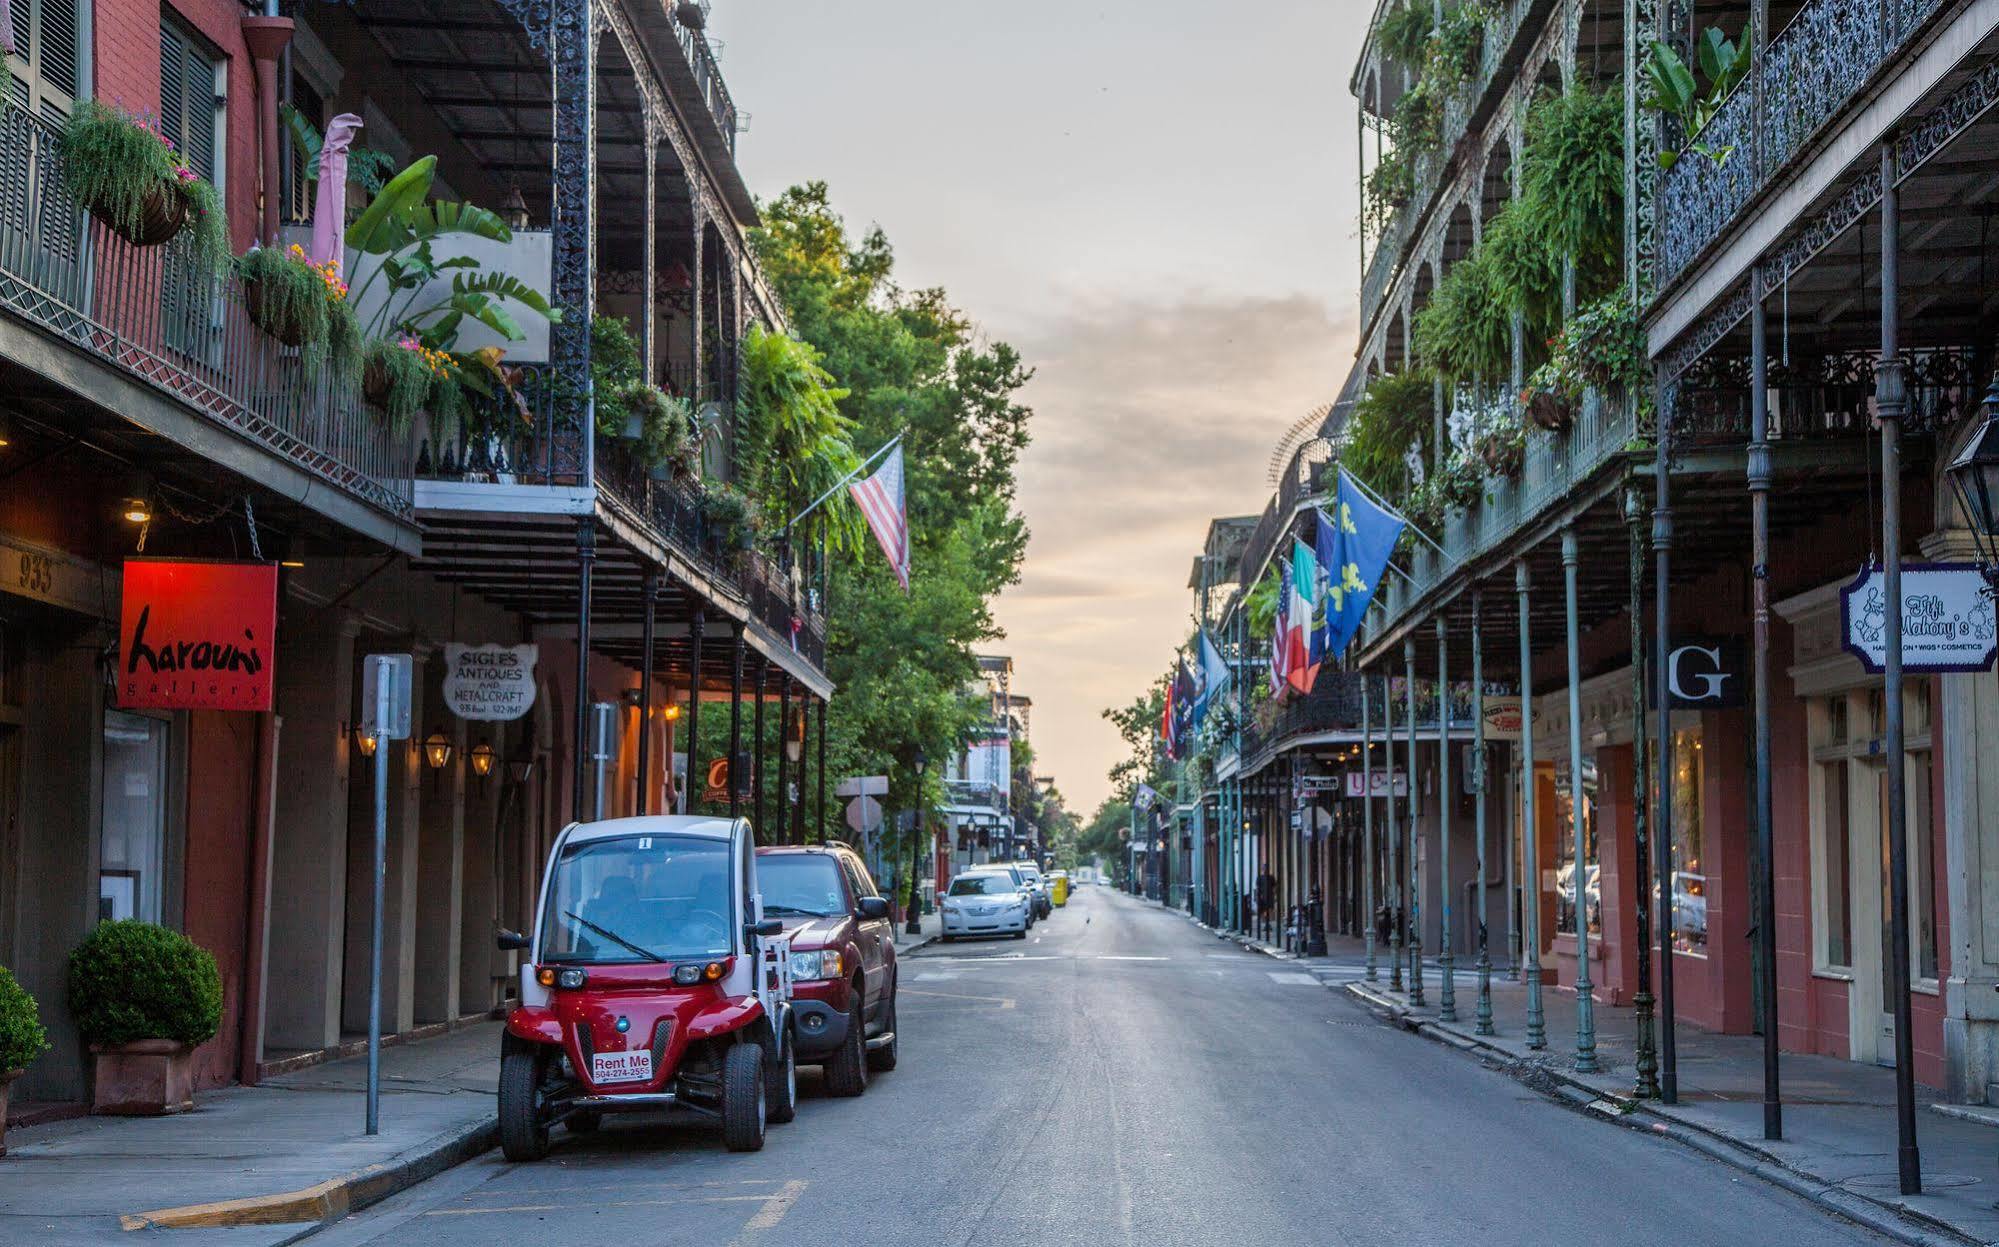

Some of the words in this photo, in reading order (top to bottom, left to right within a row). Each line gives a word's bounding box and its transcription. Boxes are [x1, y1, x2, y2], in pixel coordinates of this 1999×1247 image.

[1905, 594, 1945, 621] Fifi
[128, 604, 262, 675] harouni
[1919, 643, 1936, 651] WIGS
[1941, 643, 1983, 651] COSMETICS
[455, 668, 522, 680] ANTIQUES
[1668, 645, 1732, 700] G
[127, 681, 260, 698] gallery
[479, 681, 501, 689] AND
[454, 690, 525, 703] METALCRAFT
[595, 1058, 625, 1069] Rent
[629, 1056, 649, 1067] Me
